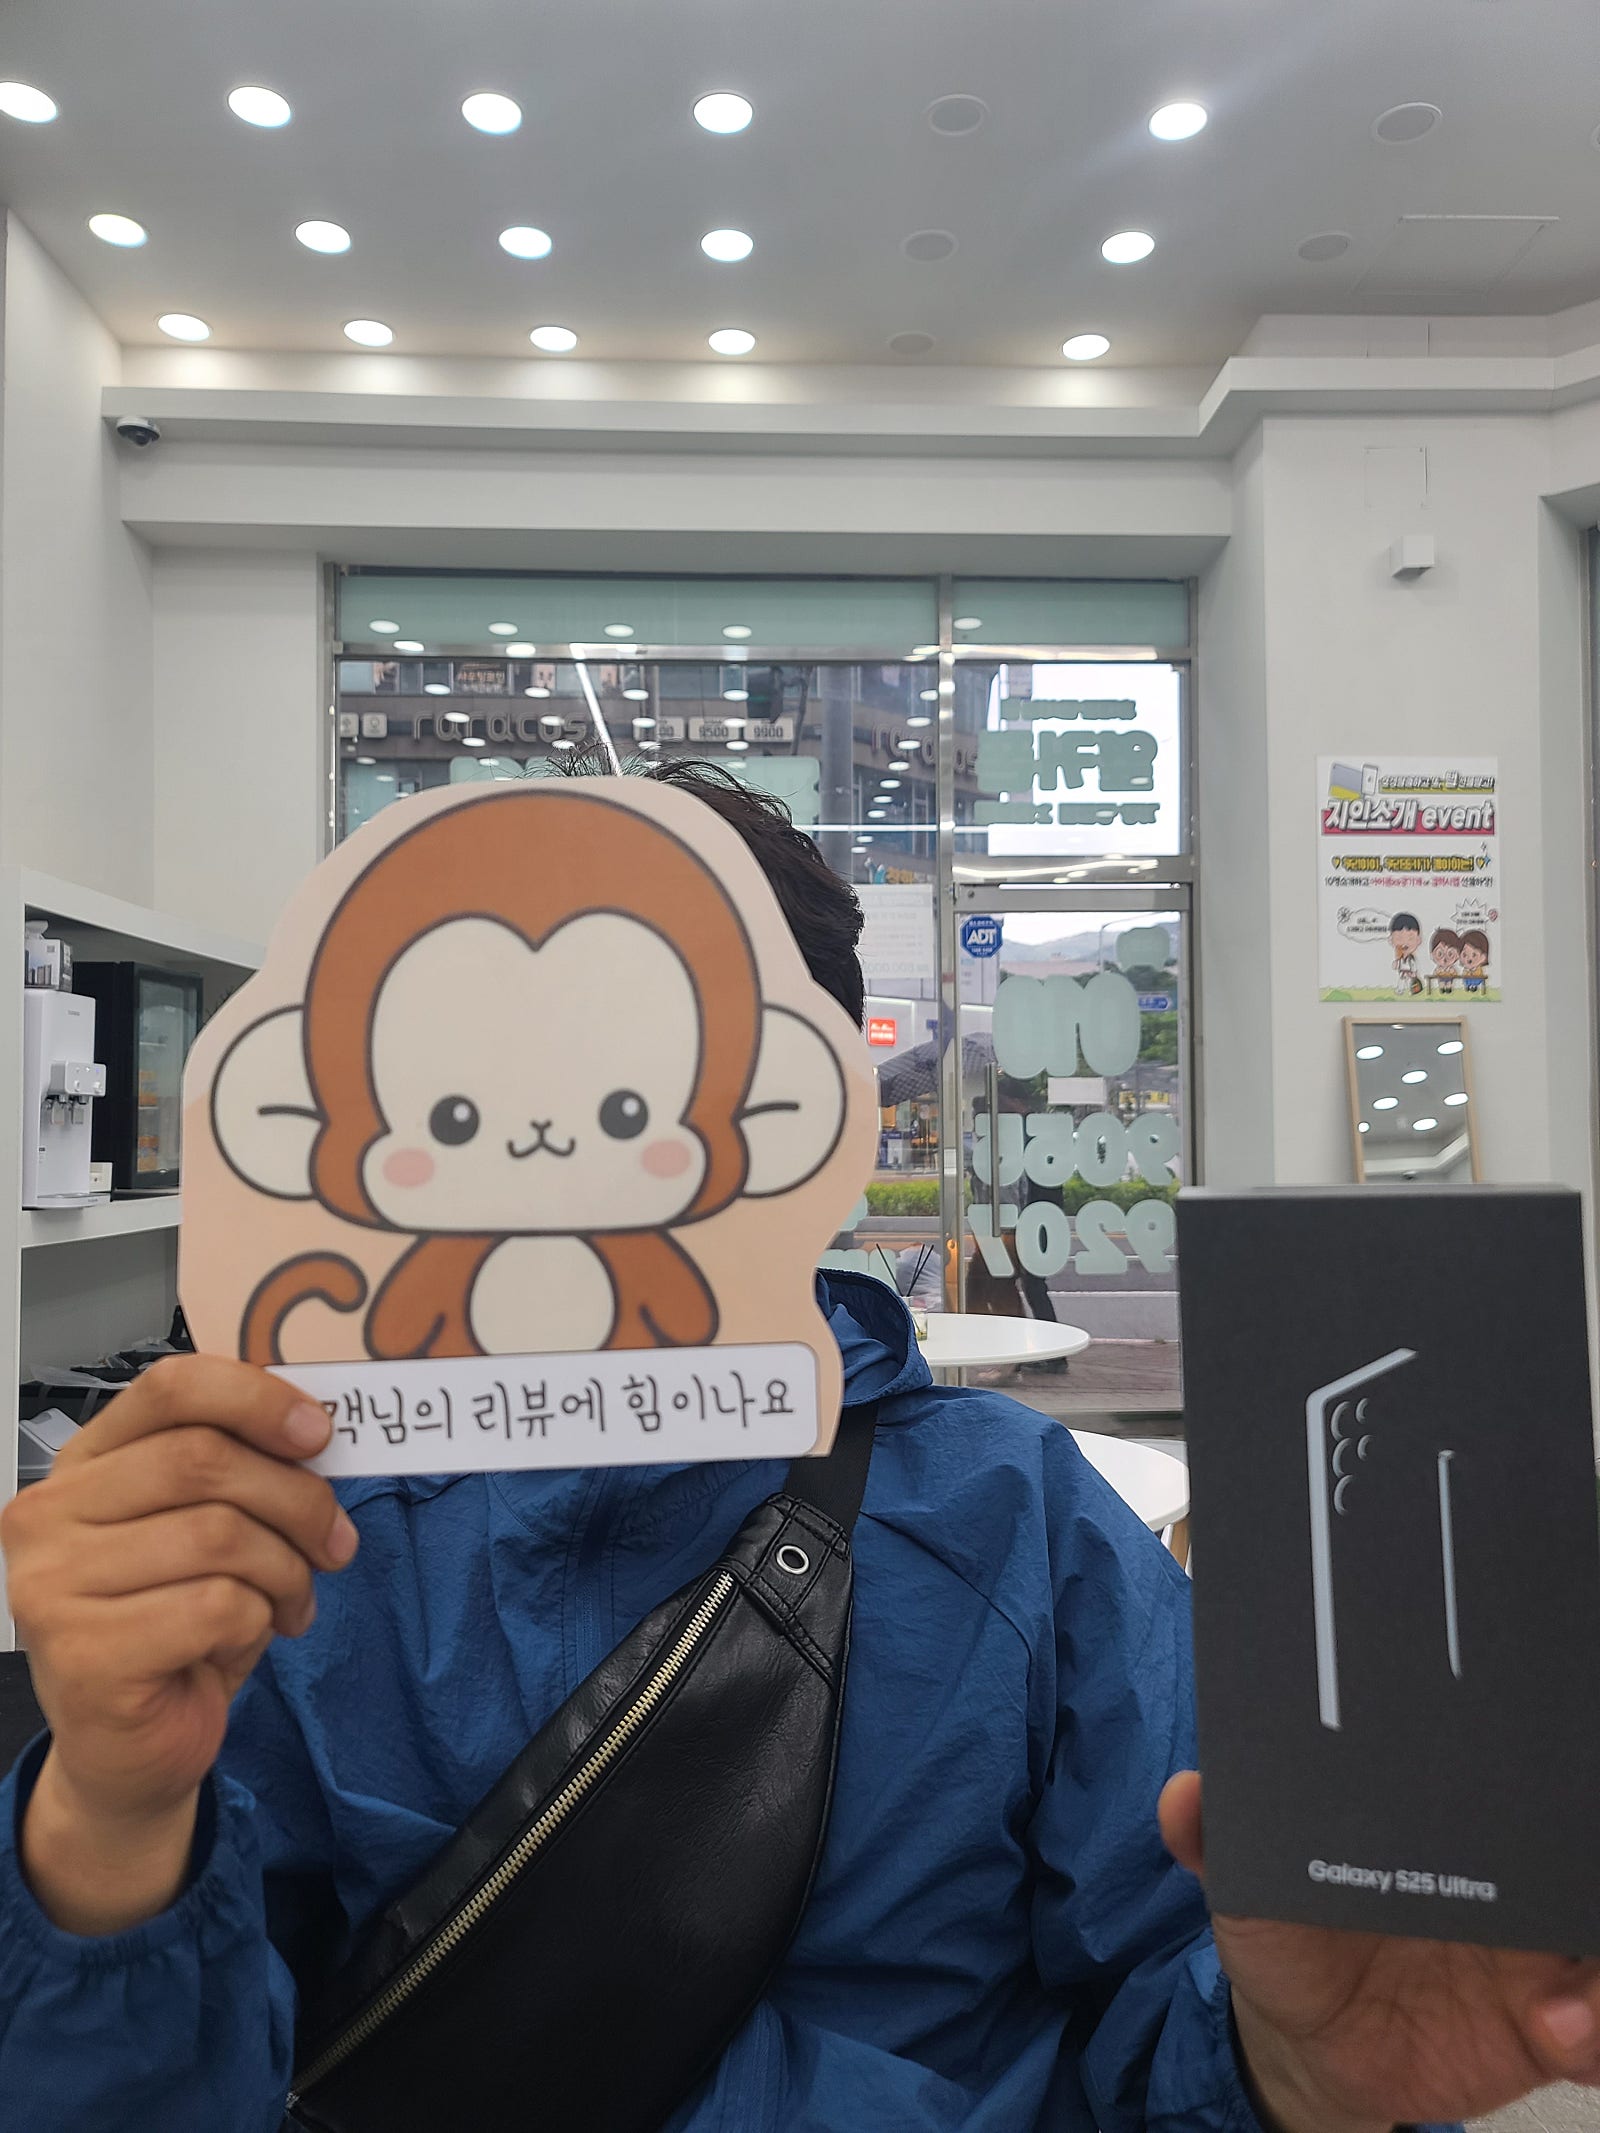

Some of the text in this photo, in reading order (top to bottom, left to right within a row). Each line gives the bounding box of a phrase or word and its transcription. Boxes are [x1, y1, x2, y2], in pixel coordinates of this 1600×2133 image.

[1324, 799, 1494, 830] 지인소개 event
[966, 929, 997, 945] ADT
[321, 1386, 453, 1445] 객님의
[472, 1377, 606, 1440] 리뷰에
[1308, 1859, 1497, 1902] Galaxy S25 Ultra
